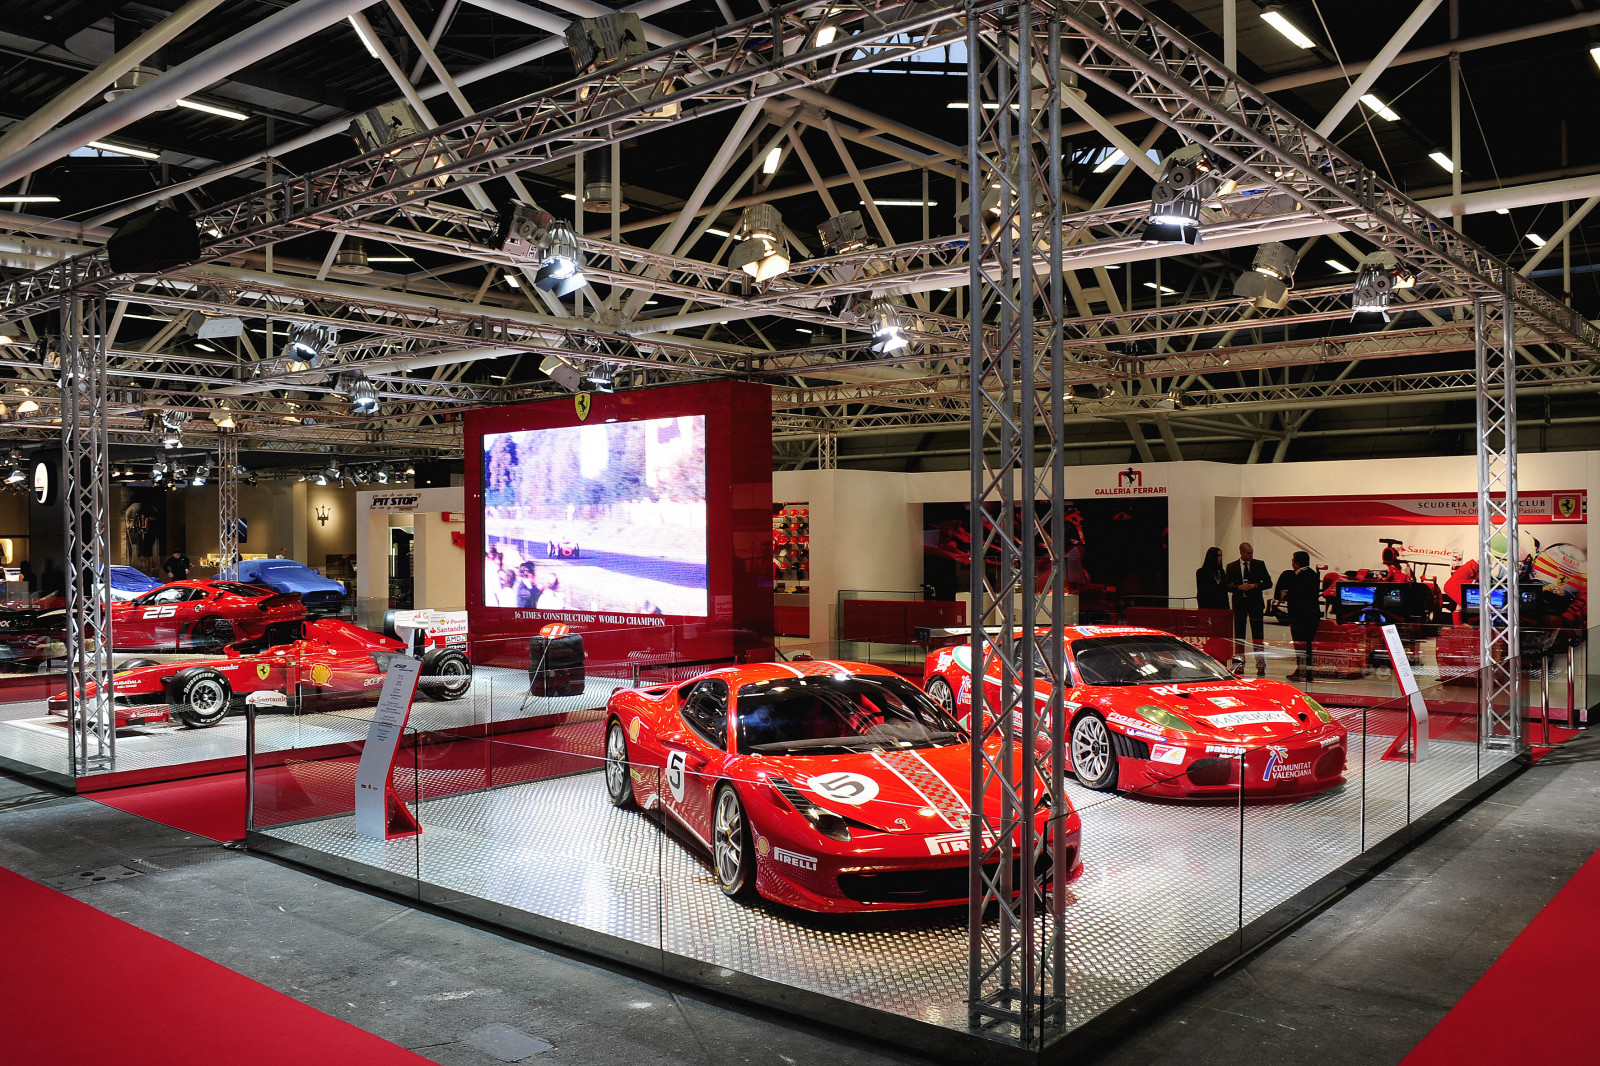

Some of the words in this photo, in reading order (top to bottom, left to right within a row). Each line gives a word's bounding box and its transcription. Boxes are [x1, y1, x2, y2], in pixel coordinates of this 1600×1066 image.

[390, 497, 418, 505] STOP
[1418, 501, 1467, 509] SCUDERIA
[1407, 545, 1452, 556] Santande
[143, 606, 178, 619] 25
[514, 611, 521, 619] 16
[522, 611, 541, 620] TIMES
[543, 612, 597, 623] CONSTRUCTORS'
[599, 615, 625, 625] WORLD
[626, 616, 666, 627] CHAMPION
[437, 624, 466, 633] Santander
[364, 677, 382, 686] acer
[1149, 684, 1189, 695] RK
[1211, 711, 1280, 725] KASPERSKY
[1205, 745, 1246, 754] pakelo
[669, 753, 683, 790] 5
[1272, 762, 1311, 772] COMUNITAT
[1272, 769, 1312, 779] VALENCIANA
[819, 775, 865, 799] 5
[774, 846, 818, 871] PIRELLI
